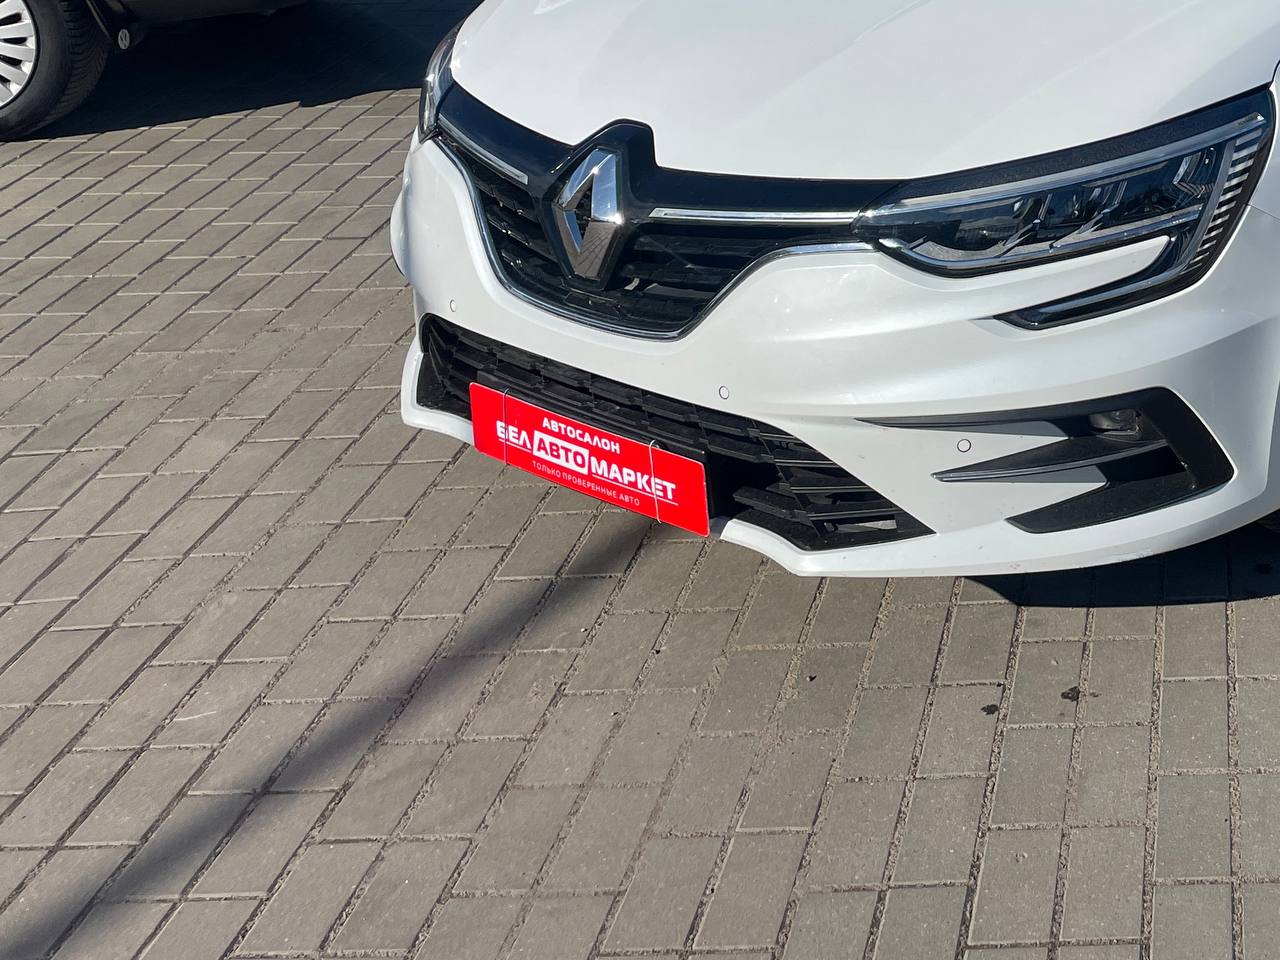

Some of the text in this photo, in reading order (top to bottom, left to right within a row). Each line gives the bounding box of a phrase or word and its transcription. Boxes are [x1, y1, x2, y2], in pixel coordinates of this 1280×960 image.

[541, 417, 621, 454] АВТОСАЛОН
[496, 420, 676, 500] БЕЛ АВТО МАРКЕТ
[532, 460, 641, 507] ТОЛЬКО ПРОВЕРЕННЫЕ АВТО
